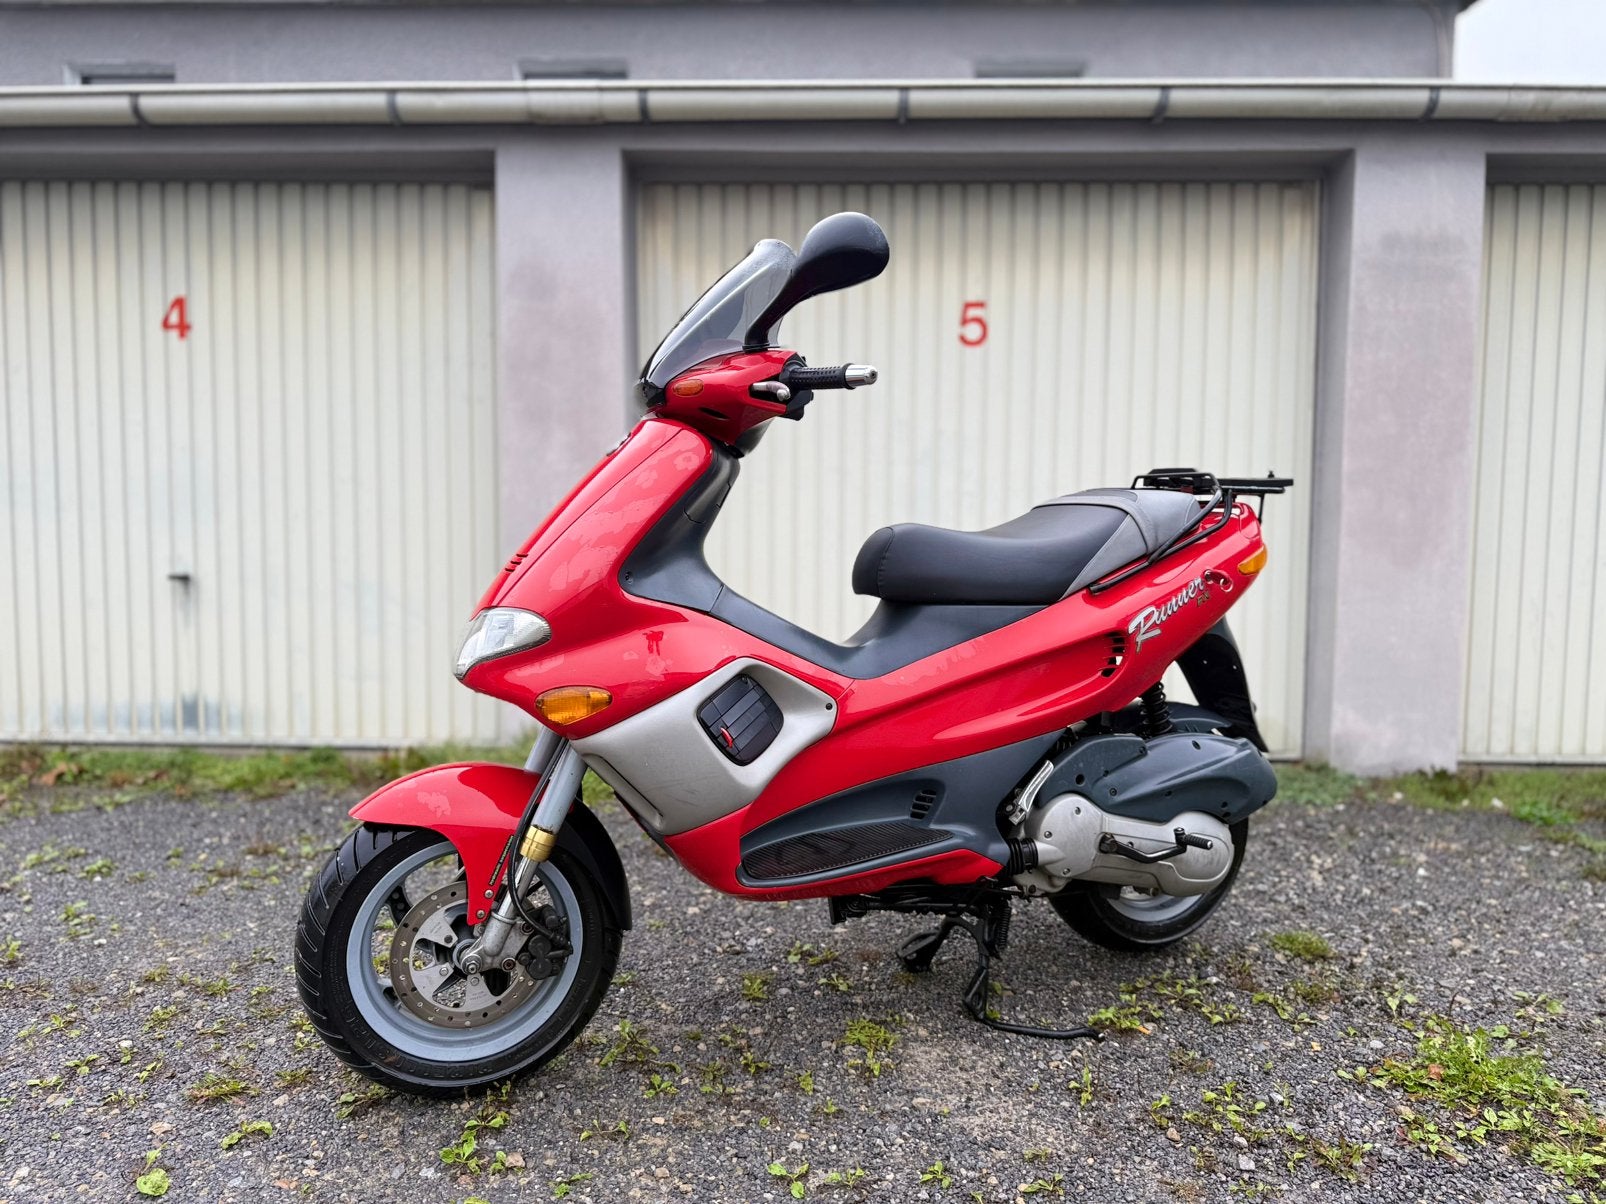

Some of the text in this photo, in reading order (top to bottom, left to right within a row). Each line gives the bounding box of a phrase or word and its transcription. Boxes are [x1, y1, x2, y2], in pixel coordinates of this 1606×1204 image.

[162, 296, 191, 340] 4
[959, 301, 988, 346] 5
[1128, 577, 1204, 653] Runner
